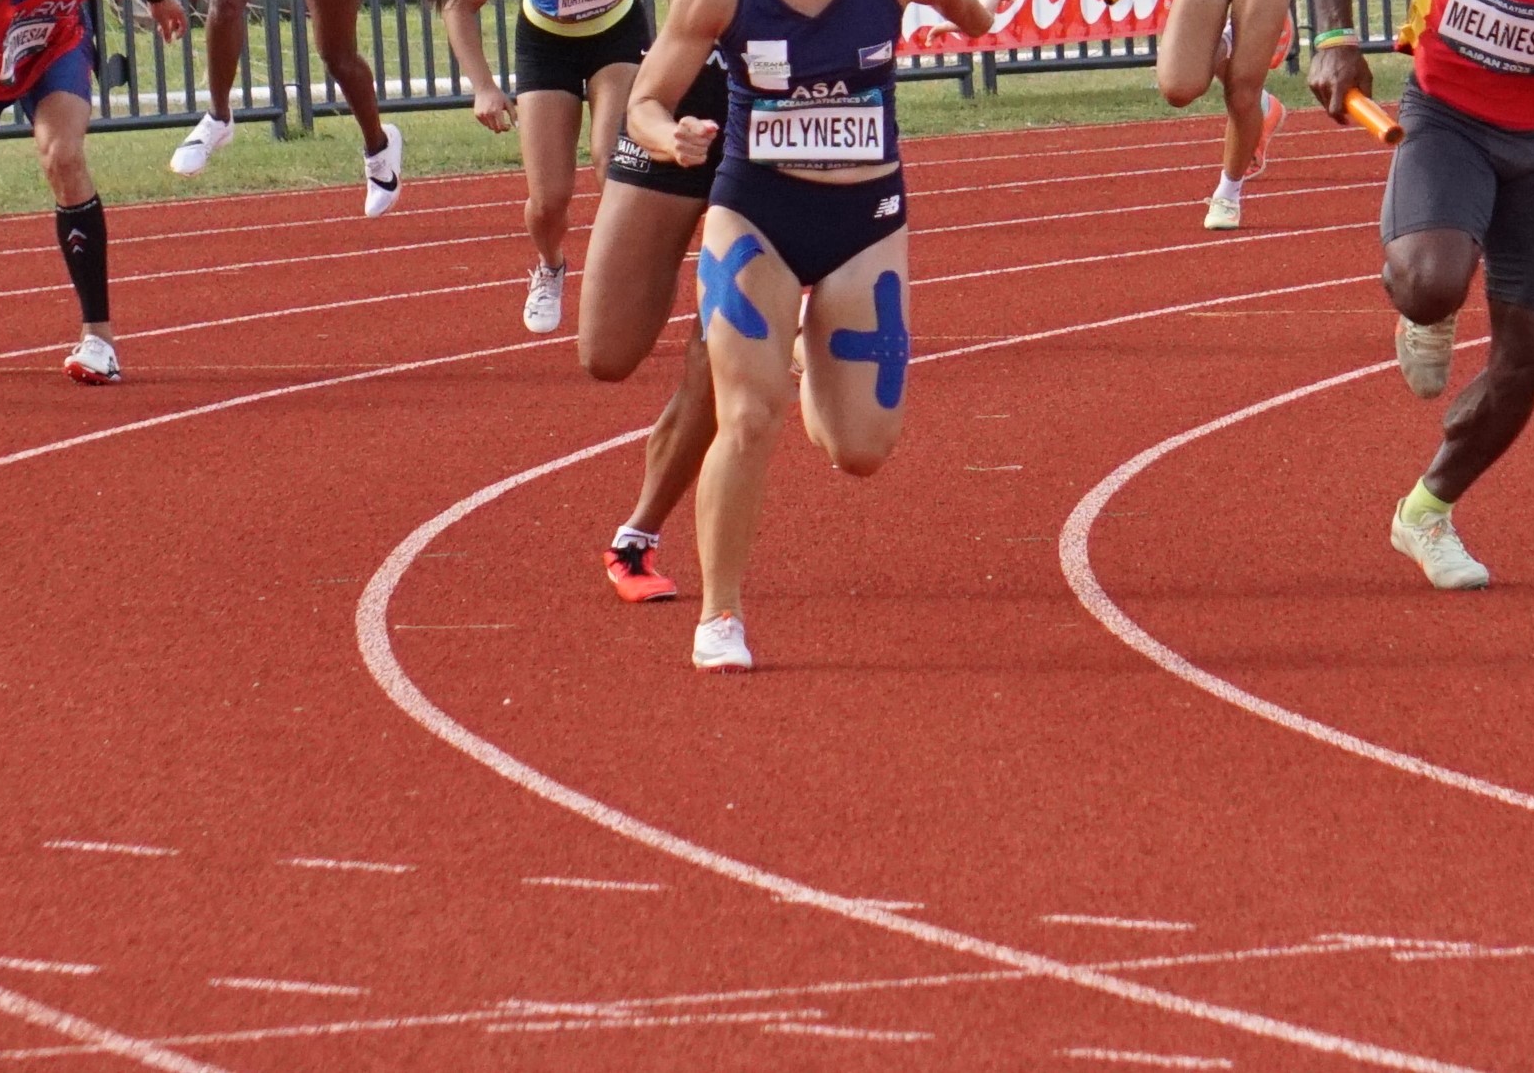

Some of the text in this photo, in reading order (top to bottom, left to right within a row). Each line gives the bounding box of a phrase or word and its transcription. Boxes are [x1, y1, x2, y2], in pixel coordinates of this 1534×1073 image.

[1459, 46, 1531, 74] SAIPAN 2023
[777, 96, 861, 108] OCEANIA ATHLETICS
[791, 80, 849, 100] ASA
[755, 116, 880, 149] POLYNESIA
